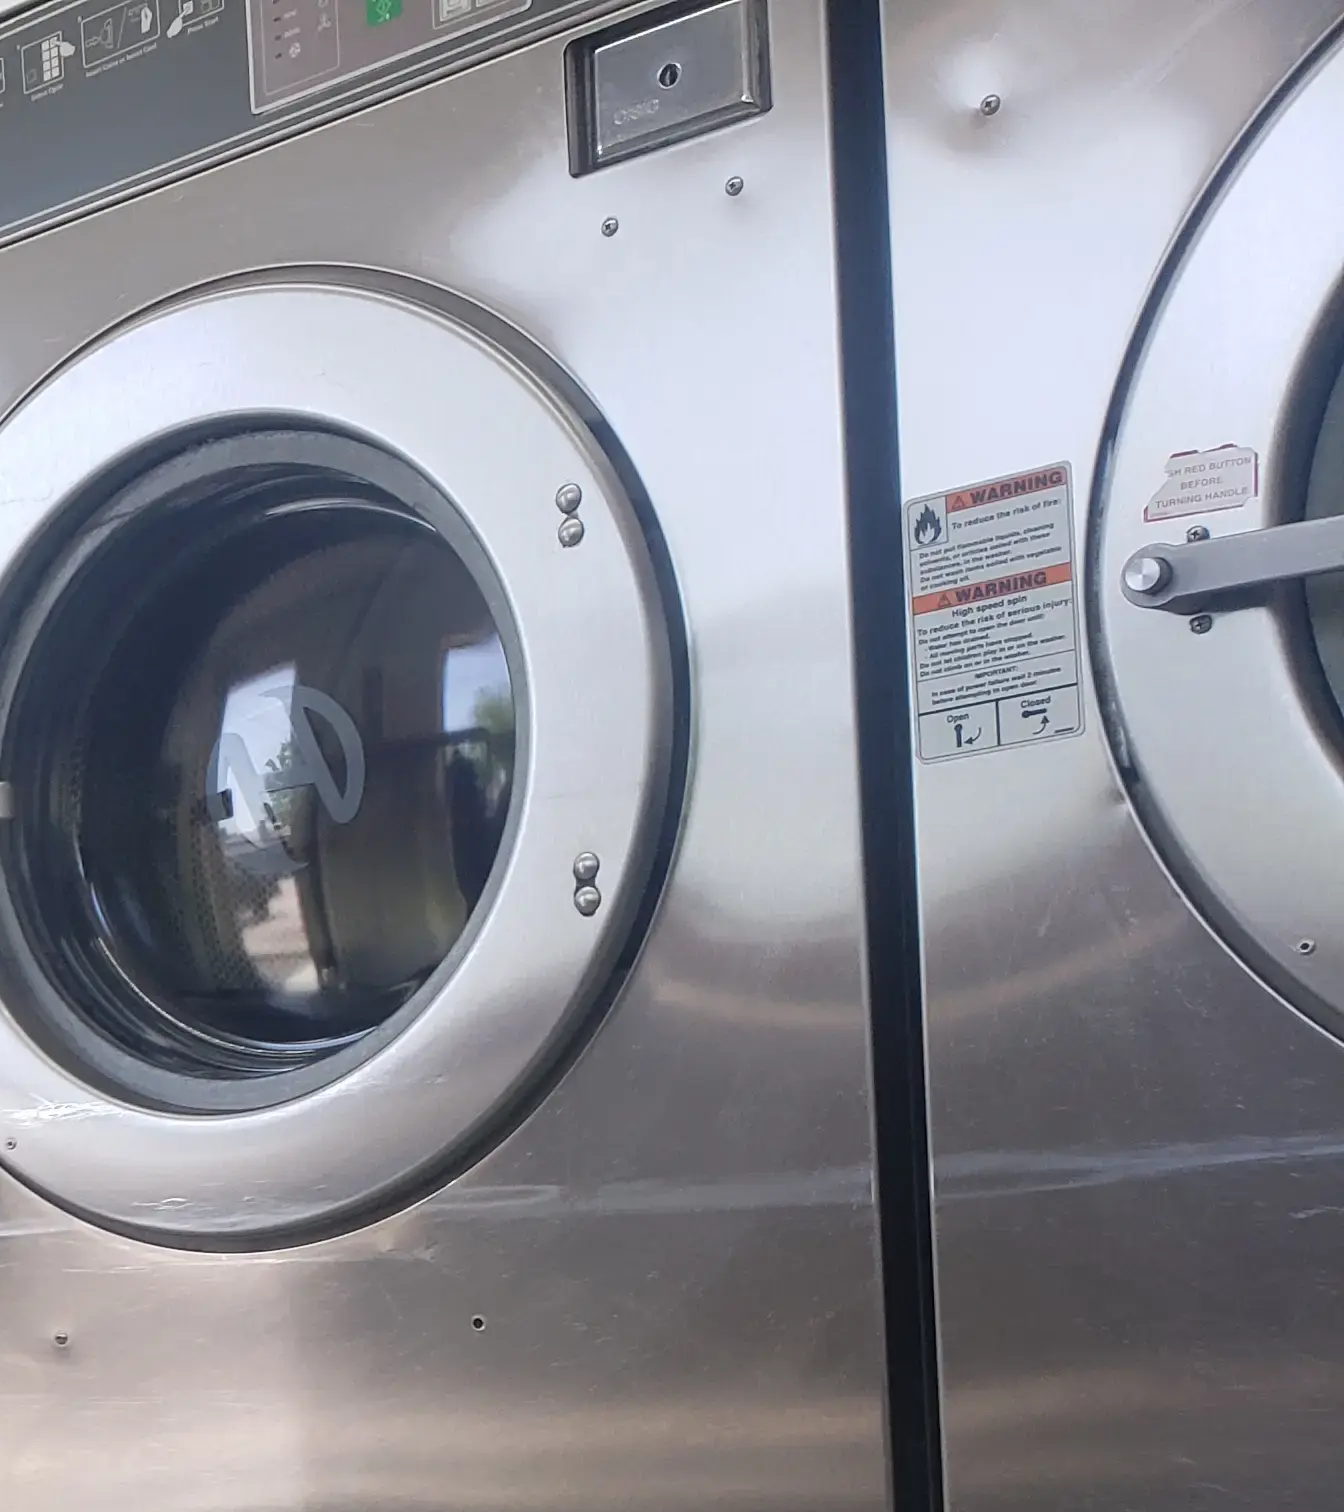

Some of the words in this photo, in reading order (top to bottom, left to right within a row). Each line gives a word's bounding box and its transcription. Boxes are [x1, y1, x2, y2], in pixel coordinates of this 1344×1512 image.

[1167, 468, 1182, 478] SH
[1184, 463, 1206, 475] RED
[1208, 456, 1252, 471] BUTTON
[970, 470, 1062, 503] WARNING
[1180, 476, 1223, 491] BEFORE
[1155, 494, 1202, 509] TURNING
[1205, 486, 1248, 501] HANDLE
[952, 521, 961, 529] To
[963, 513, 993, 526] reduce
[996, 509, 1009, 518] the
[1013, 505, 1028, 514] risk
[1031, 502, 1040, 510] of
[956, 571, 1046, 602] WARNING
[917, 628, 927, 636] To
[929, 621, 958, 633] reduce
[961, 617, 975, 626] the
[977, 613, 993, 623] risk
[1007, 603, 1040, 616] serious
[952, 606, 973, 618] High
[976, 599, 1004, 613] speed
[1007, 594, 1027, 606] spin
[946, 712, 968, 724] Open
[1020, 696, 1050, 708] Closed
